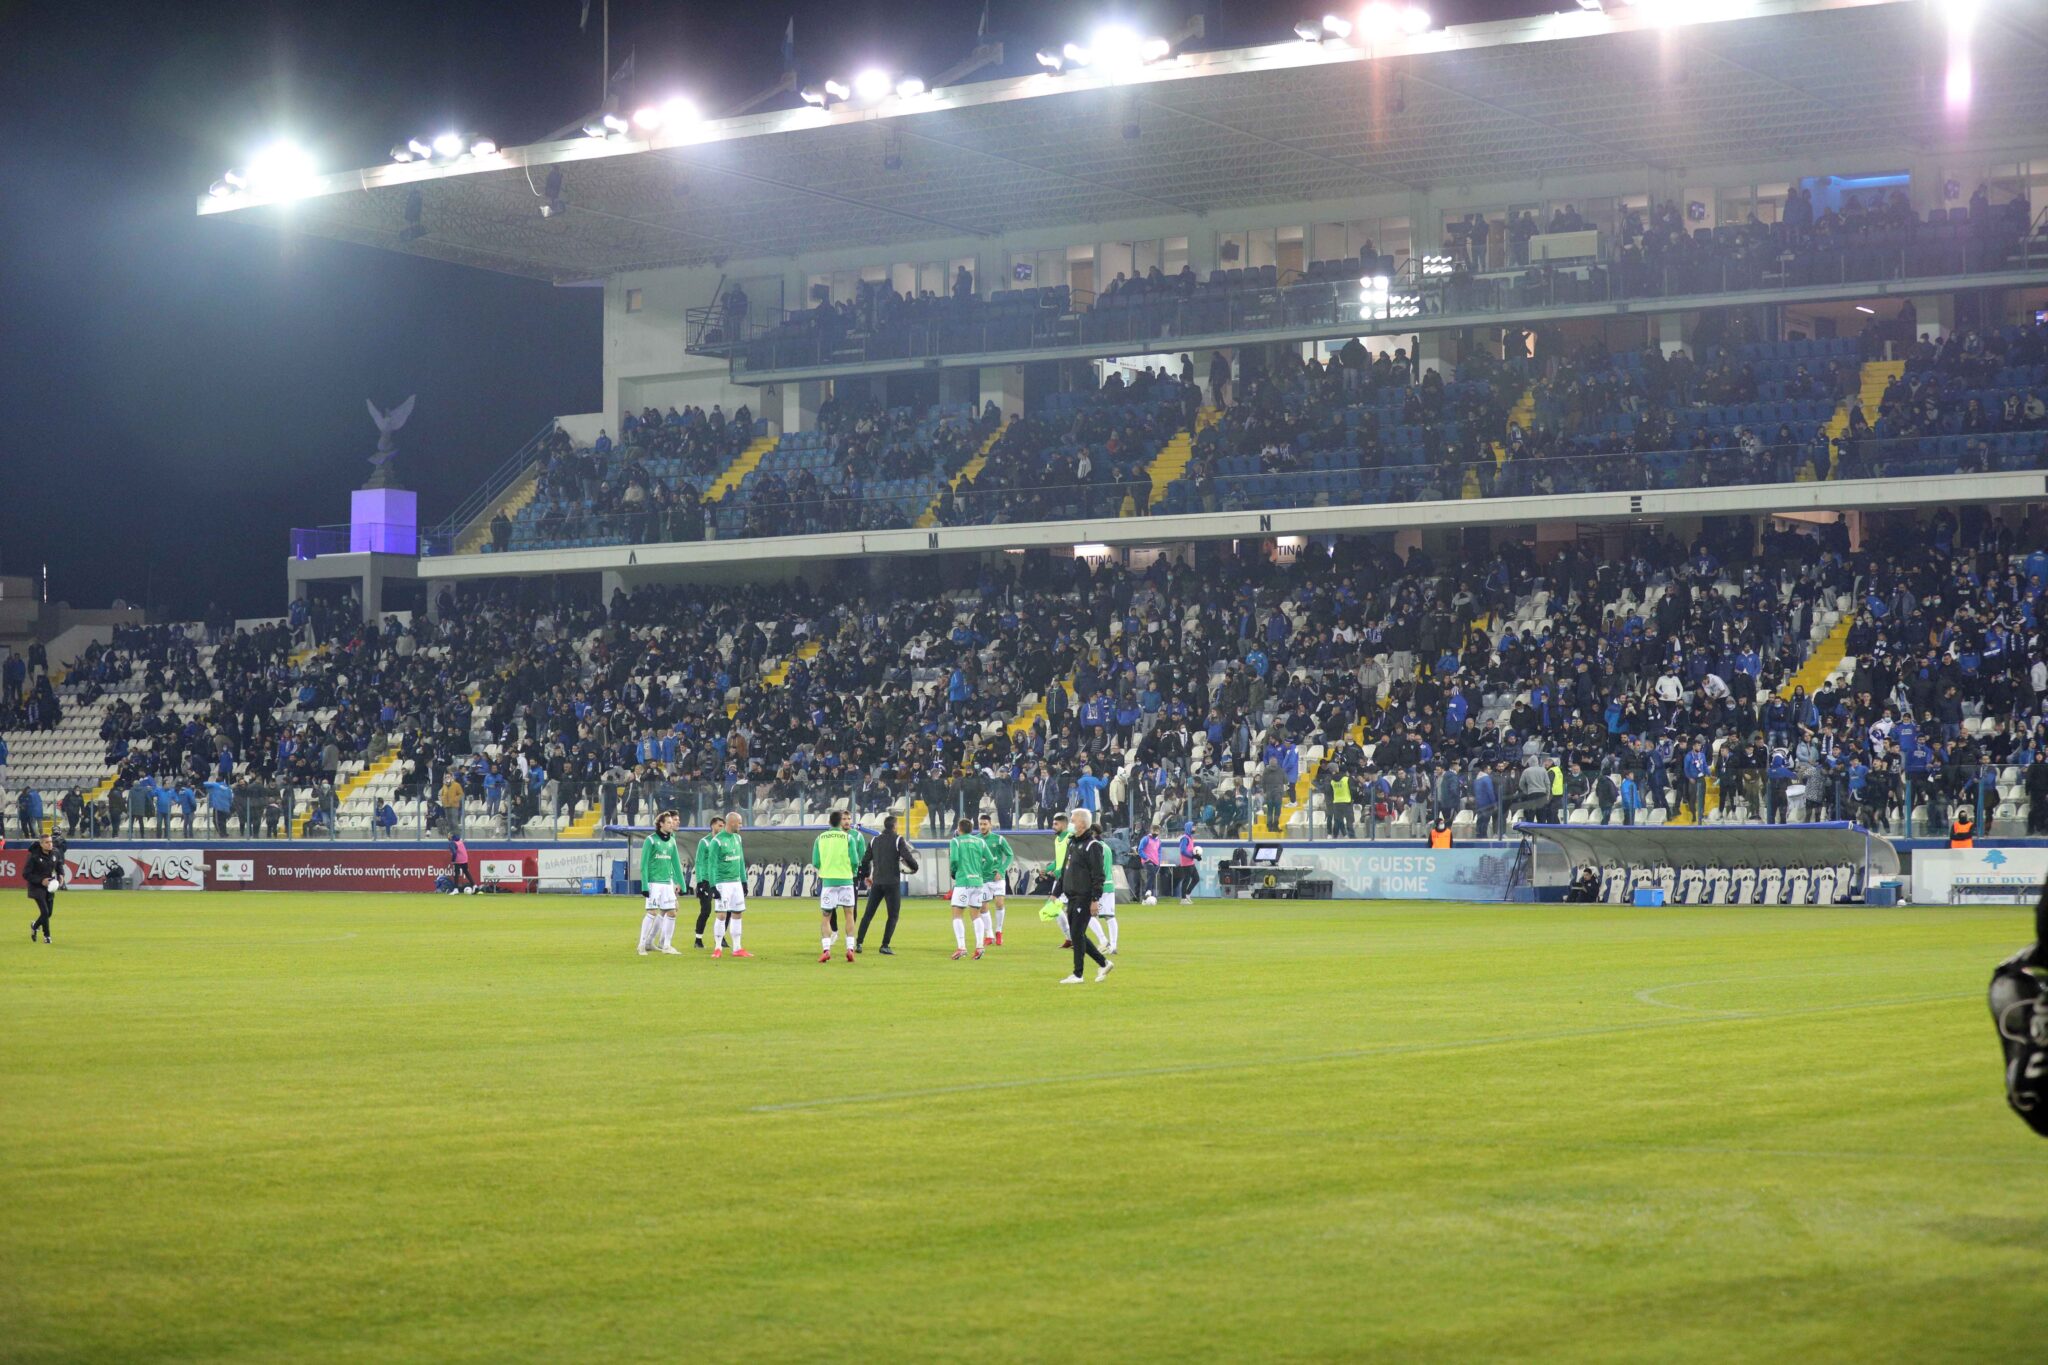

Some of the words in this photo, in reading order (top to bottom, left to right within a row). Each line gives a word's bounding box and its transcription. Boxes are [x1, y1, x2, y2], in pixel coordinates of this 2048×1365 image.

[148, 856, 193, 880] ACS
[278, 867, 292, 876] πιο
[294, 864, 331, 878] γρήγορο
[333, 864, 363, 876] δίκτυο
[365, 864, 401, 878] κινητής
[403, 867, 425, 878] στην
[1318, 856, 1363, 872] ONLY
[1368, 856, 1436, 873] GUESTS
[1338, 876, 1373, 892] OUR
[1379, 876, 1428, 892] HOME
